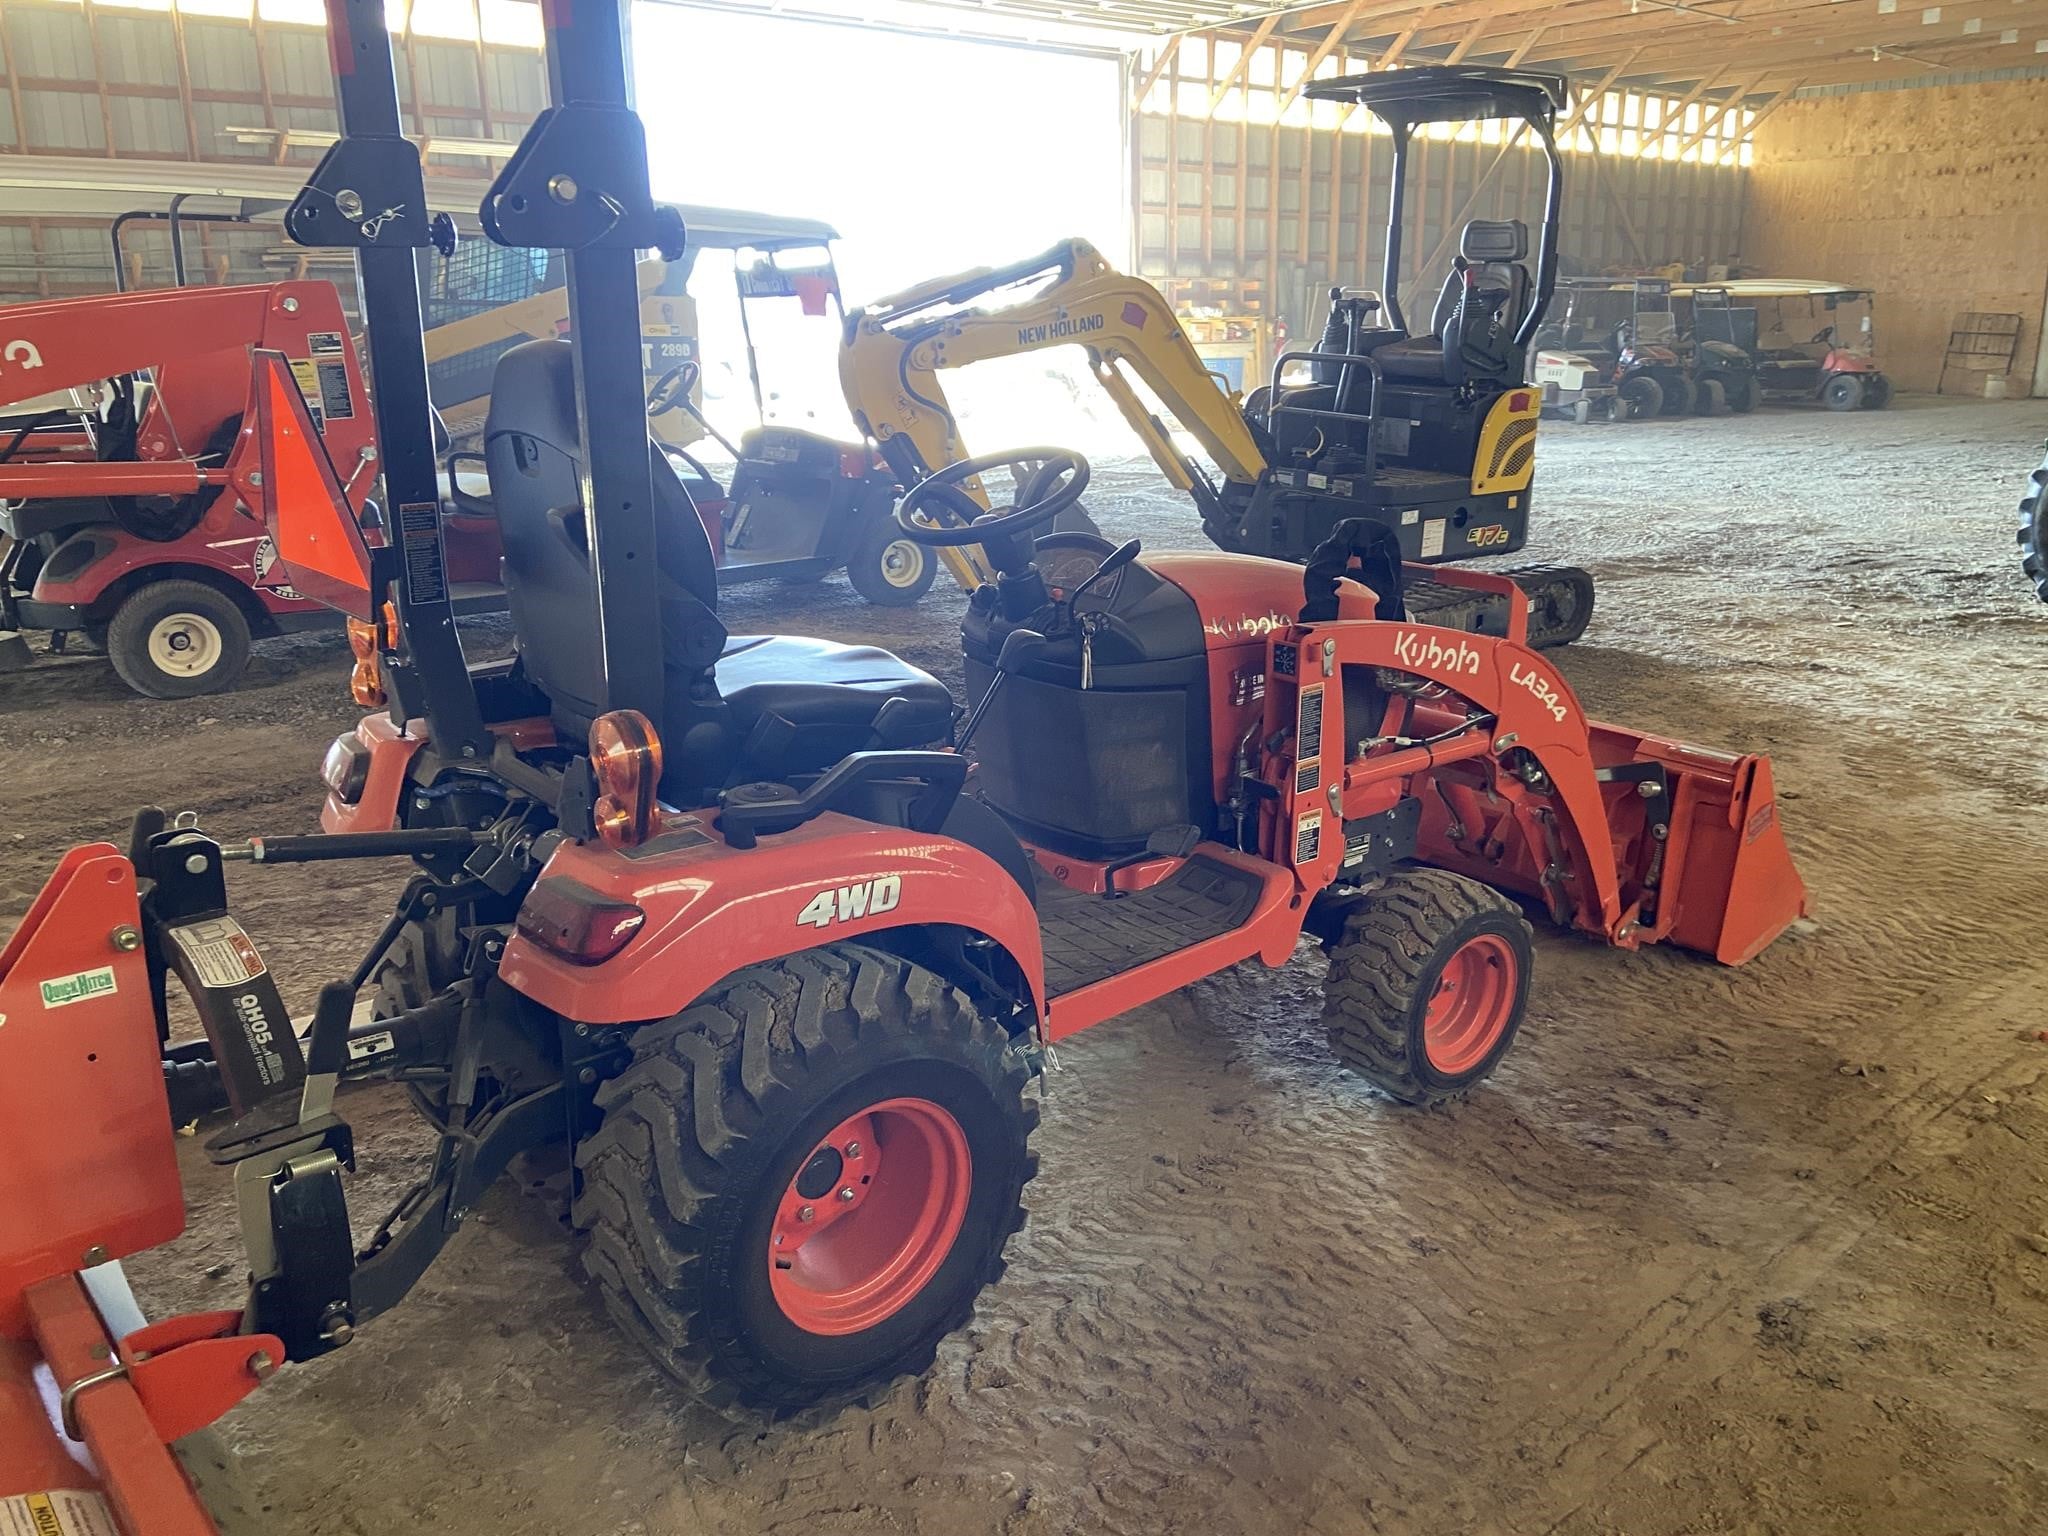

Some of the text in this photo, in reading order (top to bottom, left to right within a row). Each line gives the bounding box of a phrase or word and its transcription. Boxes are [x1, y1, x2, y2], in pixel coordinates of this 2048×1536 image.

[1018, 313, 1104, 345] NEW HOLLAND
[1394, 630, 1480, 675] Kubota
[1509, 662, 1568, 723] LA344
[796, 875, 902, 929] 4WD
[240, 993, 274, 1046] QH05
[34, 1506, 58, 1536] UTION
